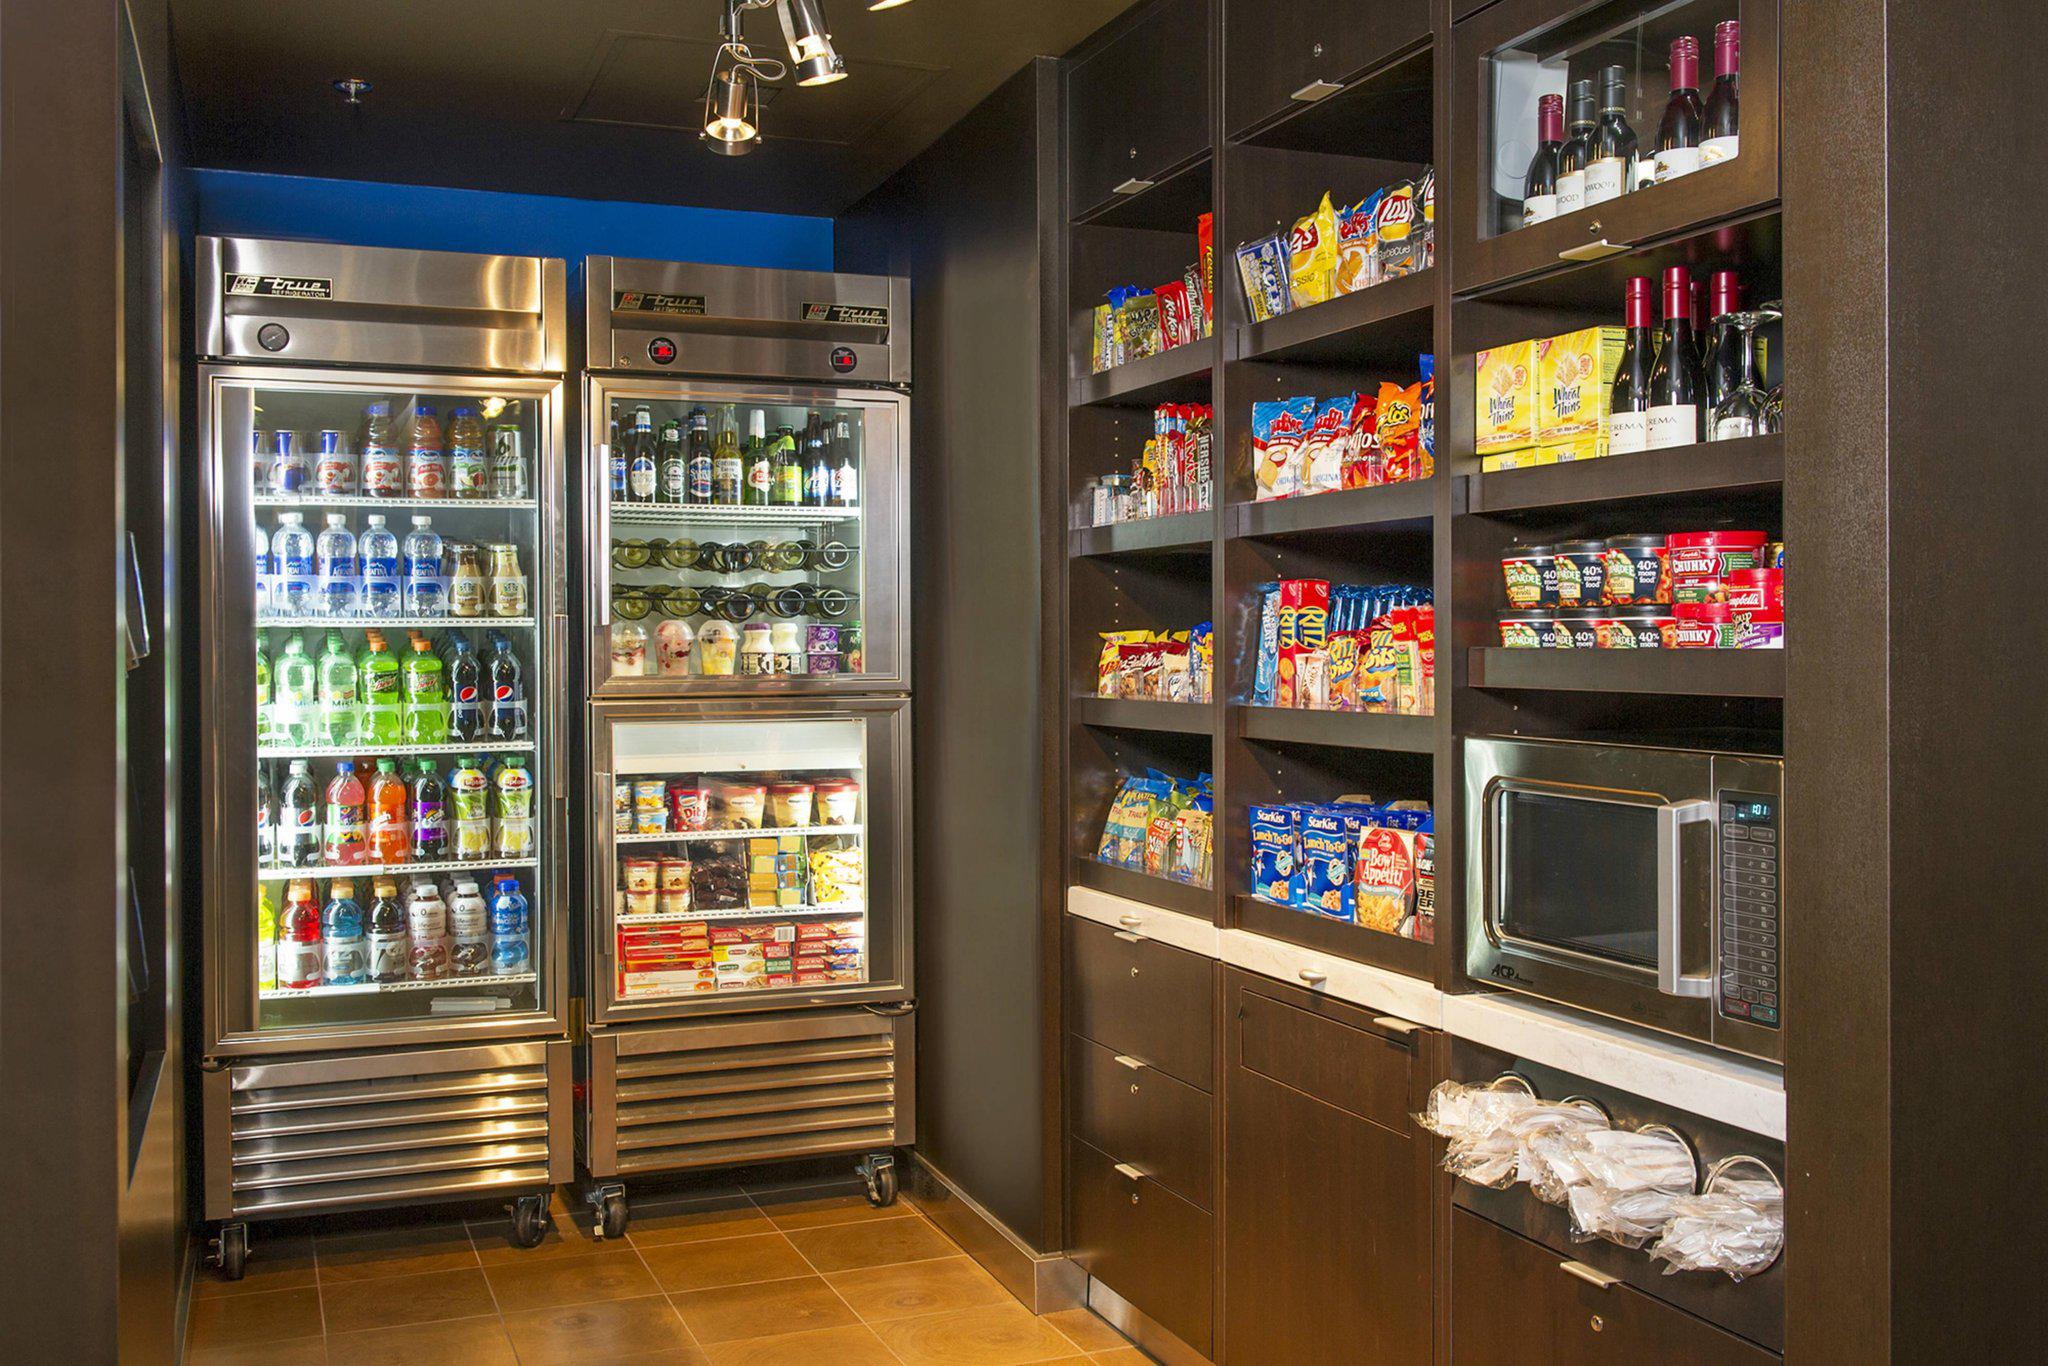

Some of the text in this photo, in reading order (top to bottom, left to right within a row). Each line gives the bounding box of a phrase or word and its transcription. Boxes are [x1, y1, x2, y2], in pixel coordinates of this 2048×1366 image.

[1553, 386, 1581, 405] Wheat
[1489, 396, 1515, 414] Wheat
[1552, 401, 1581, 418] Thins
[1488, 410, 1515, 427] Thins
[1582, 566, 1602, 576] 40%
[1636, 560, 1658, 571] 40%
[1672, 558, 1717, 574] CHUNKY
[1583, 576, 1601, 584] more
[1637, 571, 1657, 579] more
[1639, 577, 1656, 585] food
[1279, 608, 1295, 647] RITZ
[1298, 608, 1327, 648] RITZ
[1575, 631, 1595, 642] 40%
[1637, 631, 1660, 642] 40%
[1576, 641, 1594, 649] more
[1256, 809, 1286, 824] StarKist
[1307, 816, 1338, 831] StarKist
[1252, 829, 1273, 841] Lunch
[1302, 837, 1324, 851] Lunch
[1370, 847, 1396, 870] Bowl
